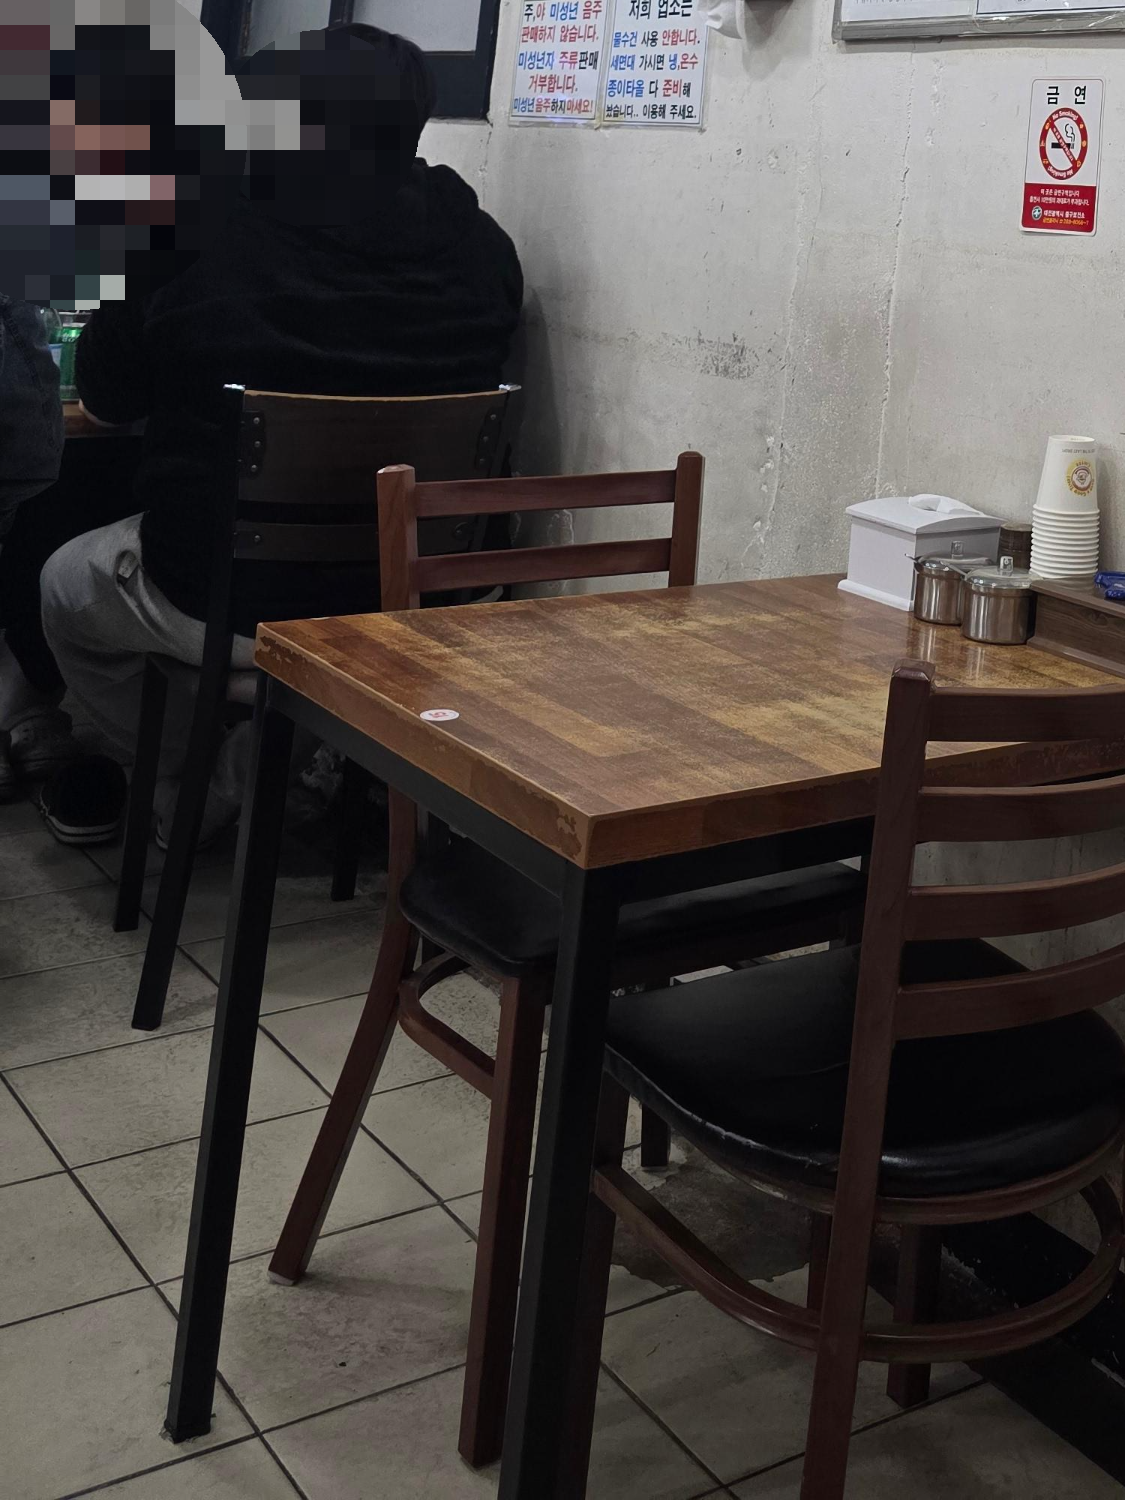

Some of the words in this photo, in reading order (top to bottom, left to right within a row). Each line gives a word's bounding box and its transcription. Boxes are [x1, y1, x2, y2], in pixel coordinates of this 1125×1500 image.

[550, 0, 579, 21] 미성년
[582, 0, 602, 19] 음주
[521, 25, 556, 43] 판매하지
[559, 24, 599, 43] 않습니다.
[613, 31, 638, 48] 물수건
[641, 30, 658, 47] 사용
[662, 28, 700, 47] 안합니다.
[518, 51, 555, 70] 미성년자
[558, 50, 599, 70] 주류판매
[610, 54, 635, 71] 세면대
[638, 53, 665, 71] 가시면
[668, 52, 698, 71] 냉,온수
[528, 74, 578, 94] 거부합니다.
[607, 79, 644, 98] 종이타올
[648, 80, 658, 98] 다
[662, 79, 691, 97] 준비해
[1047, 86, 1087, 105] 금연
[643, 103, 666, 119] 이용해
[669, 104, 696, 119] 주세요.
